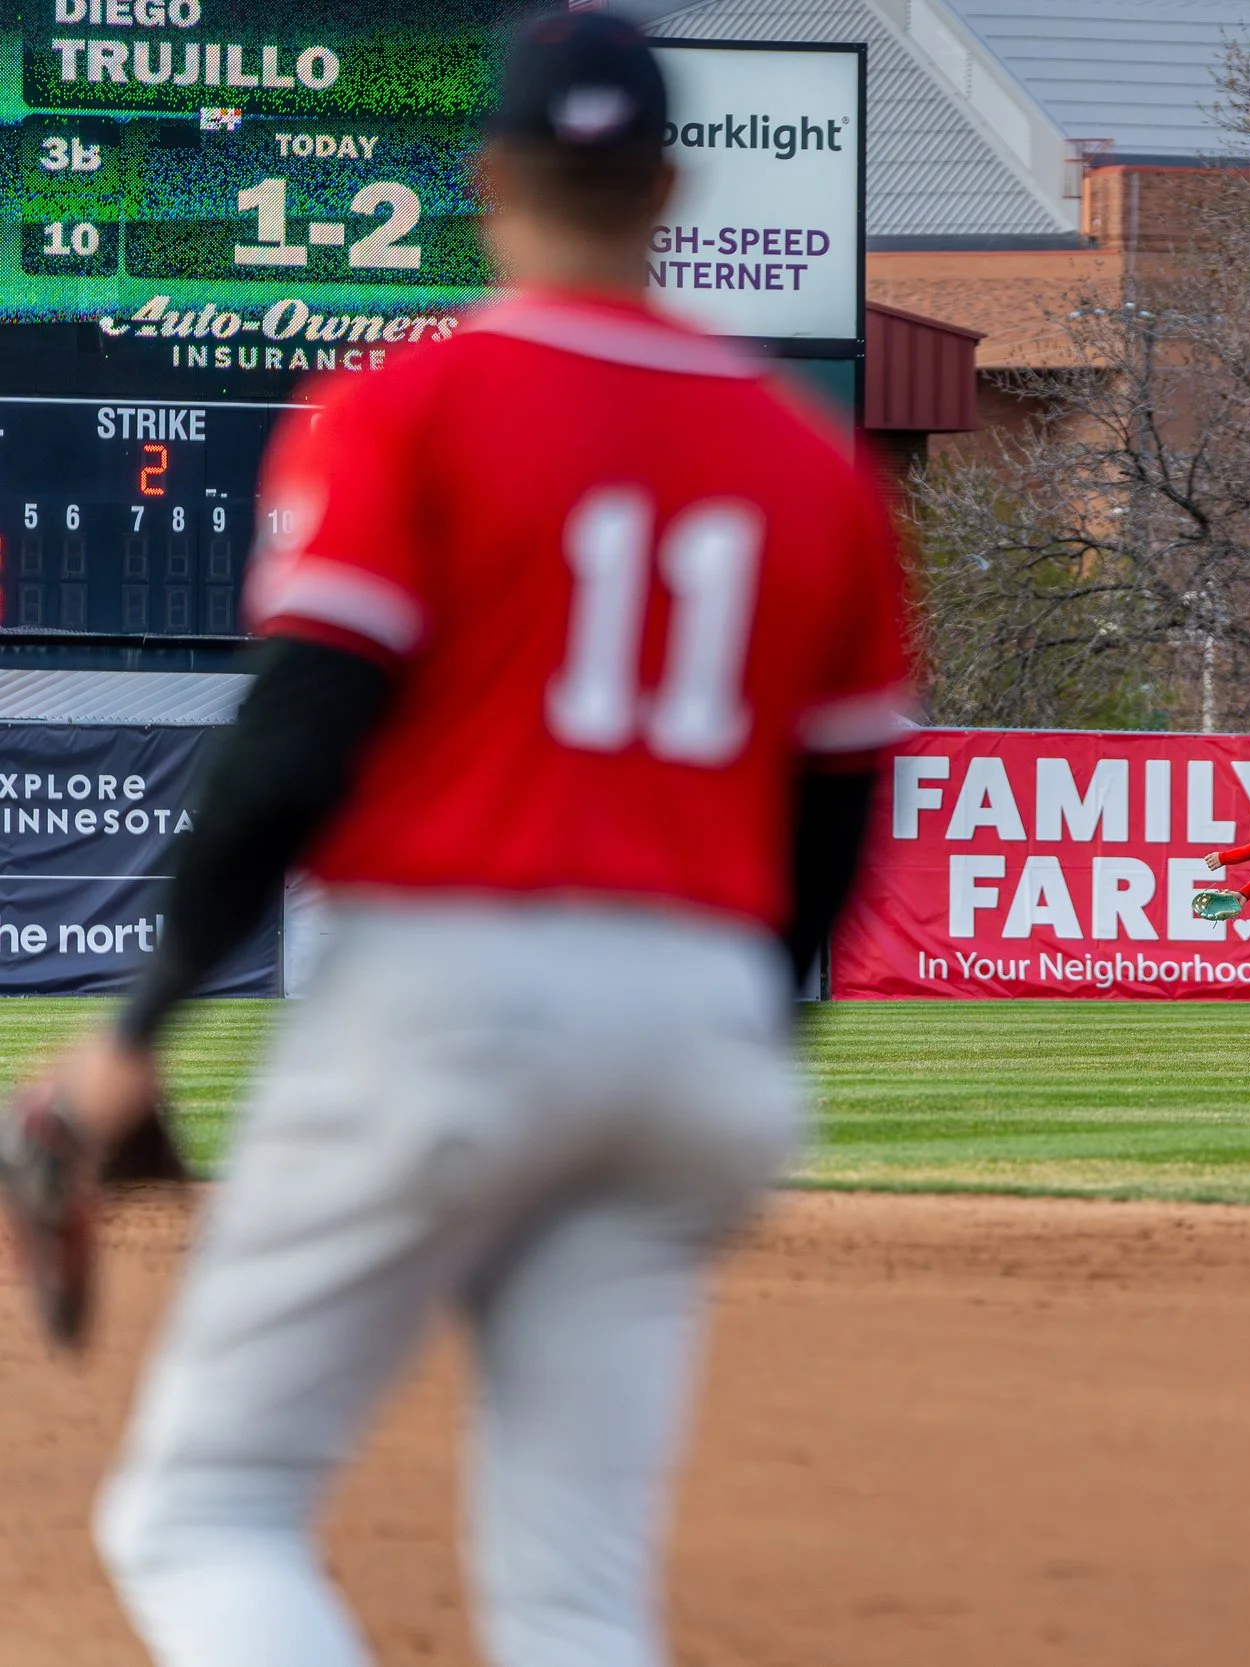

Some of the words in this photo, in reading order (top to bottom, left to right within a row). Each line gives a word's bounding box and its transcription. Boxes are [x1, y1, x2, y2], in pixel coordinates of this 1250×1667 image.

[54, 0, 201, 28] DIEGO
[52, 38, 340, 91] TRUJILLO
[275, 132, 379, 159] TODAY
[43, 221, 100, 256] 10
[234, 177, 421, 270] 1-2
[99, 295, 460, 343] Auto-Owners
[172, 344, 387, 372] INSURANCE
[97, 407, 206, 442] STRIKE
[140, 445, 168, 496] 2
[24, 503, 38, 529] 5
[66, 504, 80, 531] 6
[131, 506, 144, 532] 7
[172, 506, 185, 533] 8
[212, 507, 226, 533] 9
[545, 480, 767, 769] 11
[919, 951, 949, 980] In
[955, 951, 1031, 981] Your
